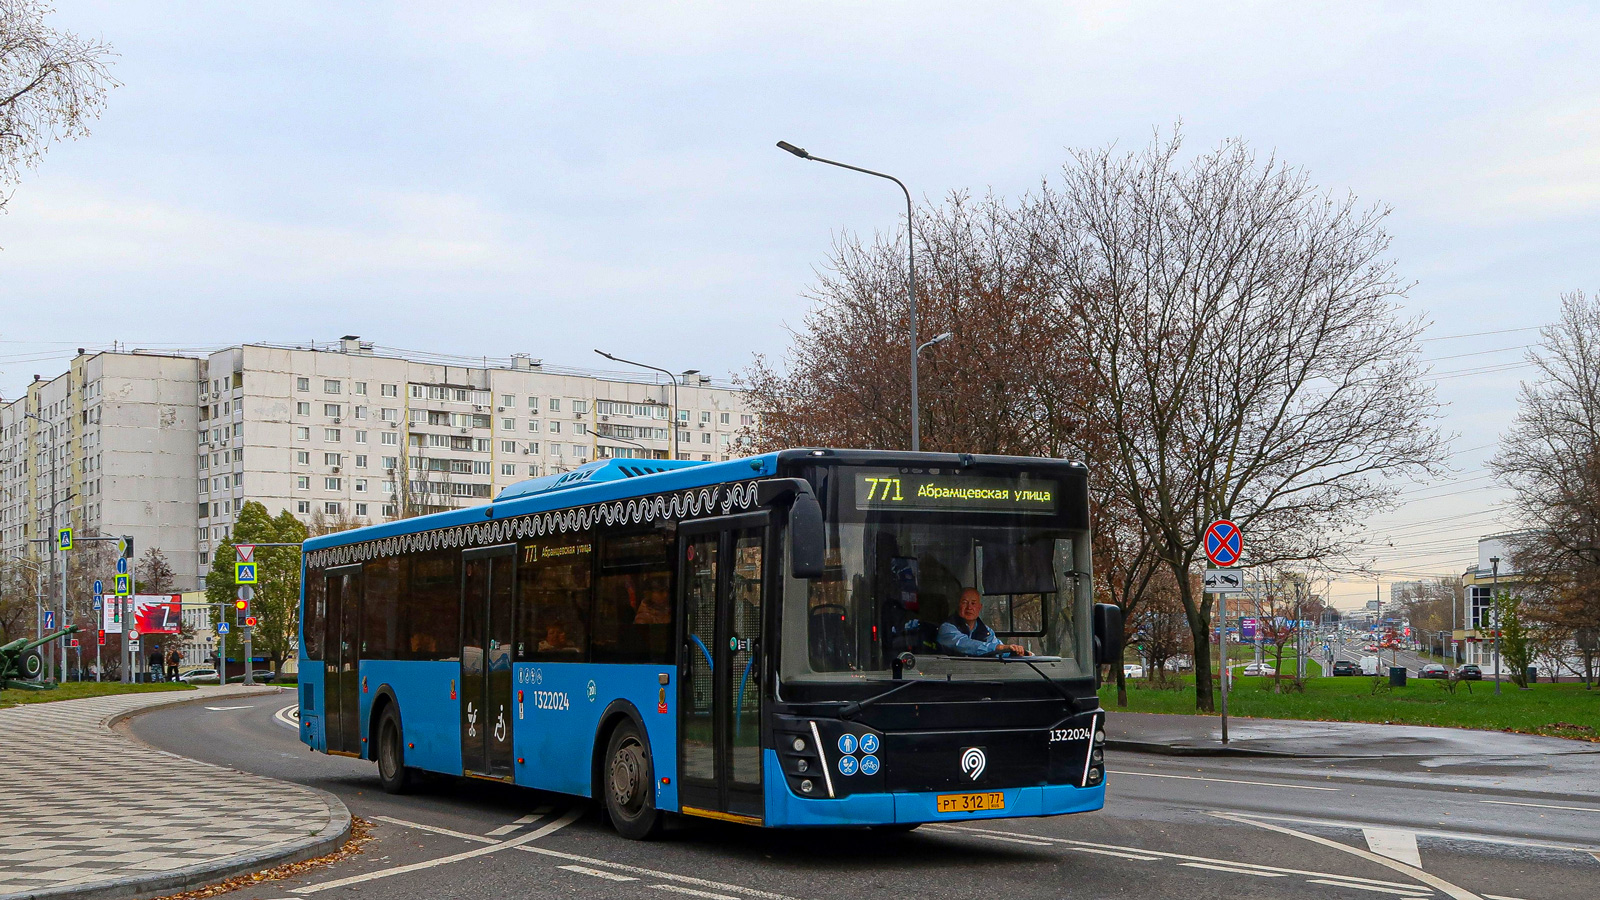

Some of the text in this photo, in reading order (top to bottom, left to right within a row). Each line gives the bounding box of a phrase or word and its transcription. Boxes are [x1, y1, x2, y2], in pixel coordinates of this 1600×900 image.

[864, 477, 1051, 502] 771 Абрамцевская улица
[524, 544, 538, 563] 771
[161, 606, 170, 627] 7
[533, 690, 570, 711] 1322024
[1050, 728, 1090, 742] 1322024
[962, 795, 983, 809] 312
[989, 793, 1000, 804] 77
